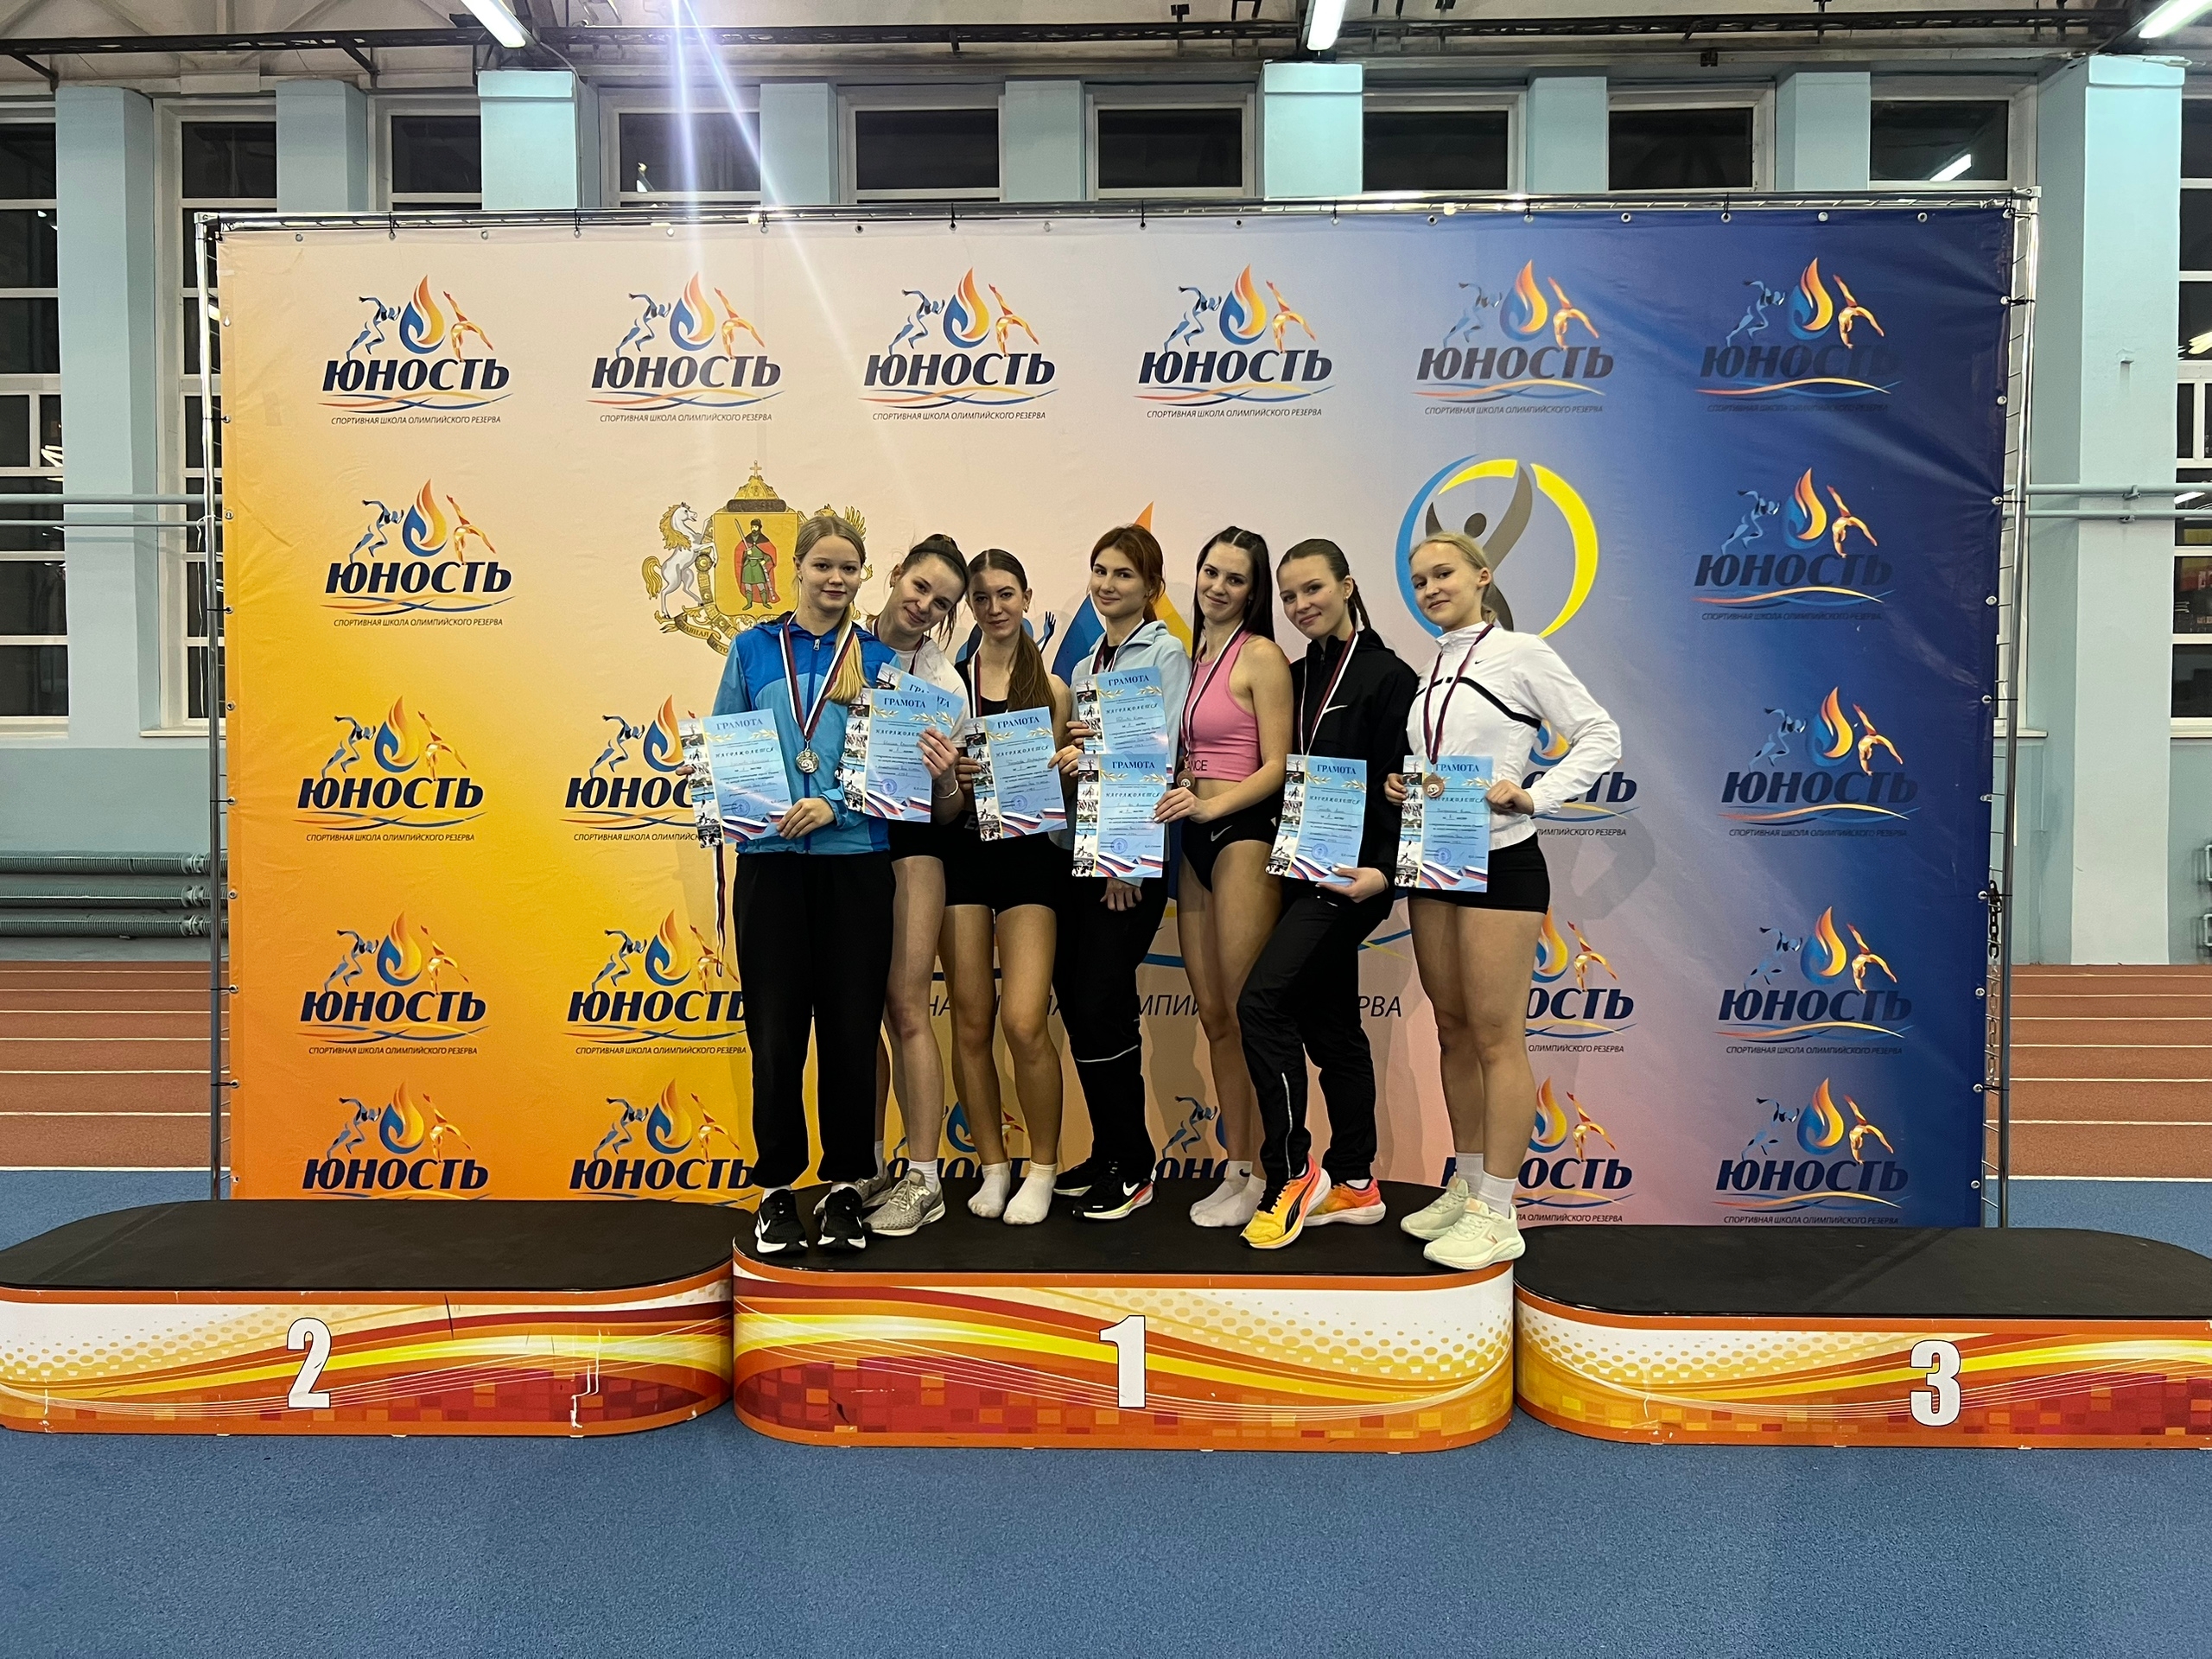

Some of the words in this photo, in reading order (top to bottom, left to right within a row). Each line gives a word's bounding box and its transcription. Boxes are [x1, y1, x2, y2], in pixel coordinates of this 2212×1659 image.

[322, 358, 509, 391] ЮНОСТЬ
[591, 355, 781, 390] ЮНОСТЬ
[864, 353, 1056, 386] ЮНОСТЬ
[1138, 349, 1332, 385] ЮНОСТЬ
[1416, 346, 1613, 380] ЮНОСТЬ
[408, 416, 470, 424] ОЛИМПИЙСКОГО
[677, 413, 741, 422] ОЛИМПИЙСКОГО
[950, 411, 1014, 420] ОЛИМПИЙСКОГО
[1226, 409, 1290, 417] ОЛИМПИЙСКОГО
[1505, 405, 1571, 414] ОЛИМПИЙСКОГО
[326, 561, 512, 594] ЮНОСТЬ
[1694, 553, 1891, 588] ЮНОСТЬ
[410, 618, 472, 626] ОЛИМПИЙСКОГО
[1109, 676, 1149, 686] ГРАМОТА
[884, 698, 926, 709] ГРАМОТА
[716, 718, 763, 730] ГРАМОТА
[998, 716, 1039, 728] ГРАМОТА
[1317, 764, 1357, 774] ГРАМОТА
[297, 777, 483, 810] ЮНОСТЬ
[565, 777, 693, 808] ЮНОС
[1722, 771, 1918, 804] ЮНОСТЬ
[382, 833, 444, 842] ОЛИМПИЙСКОГО
[1536, 827, 1594, 836] ЛИМПИЙСКОГО
[300, 990, 486, 1022] ЮНОСТЬ
[1526, 988, 1634, 1020] ОСТЬ
[1719, 988, 1911, 1021] ЮНОСТЬ
[385, 1046, 447, 1054] ОЛИМПИЙСКОГО
[653, 1046, 715, 1054] ОЛИМПИЙСКОГО
[1528, 1044, 1592, 1052] ОЛИМПИЙСКОГО
[1806, 1046, 1871, 1054] ОЛИМПИЙСКОГО
[302, 1158, 488, 1191] ЮНОСТЬ
[569, 1159, 755, 1189] ЮНОСТЬ
[1716, 1159, 1909, 1191] ЮНОСТЬ
[1802, 1216, 1866, 1224] ОЛИМПИЙСКОГО
[287, 1318, 332, 1409] 2
[1099, 1314, 1147, 1408] 1
[1909, 1339, 1962, 1427] 3
